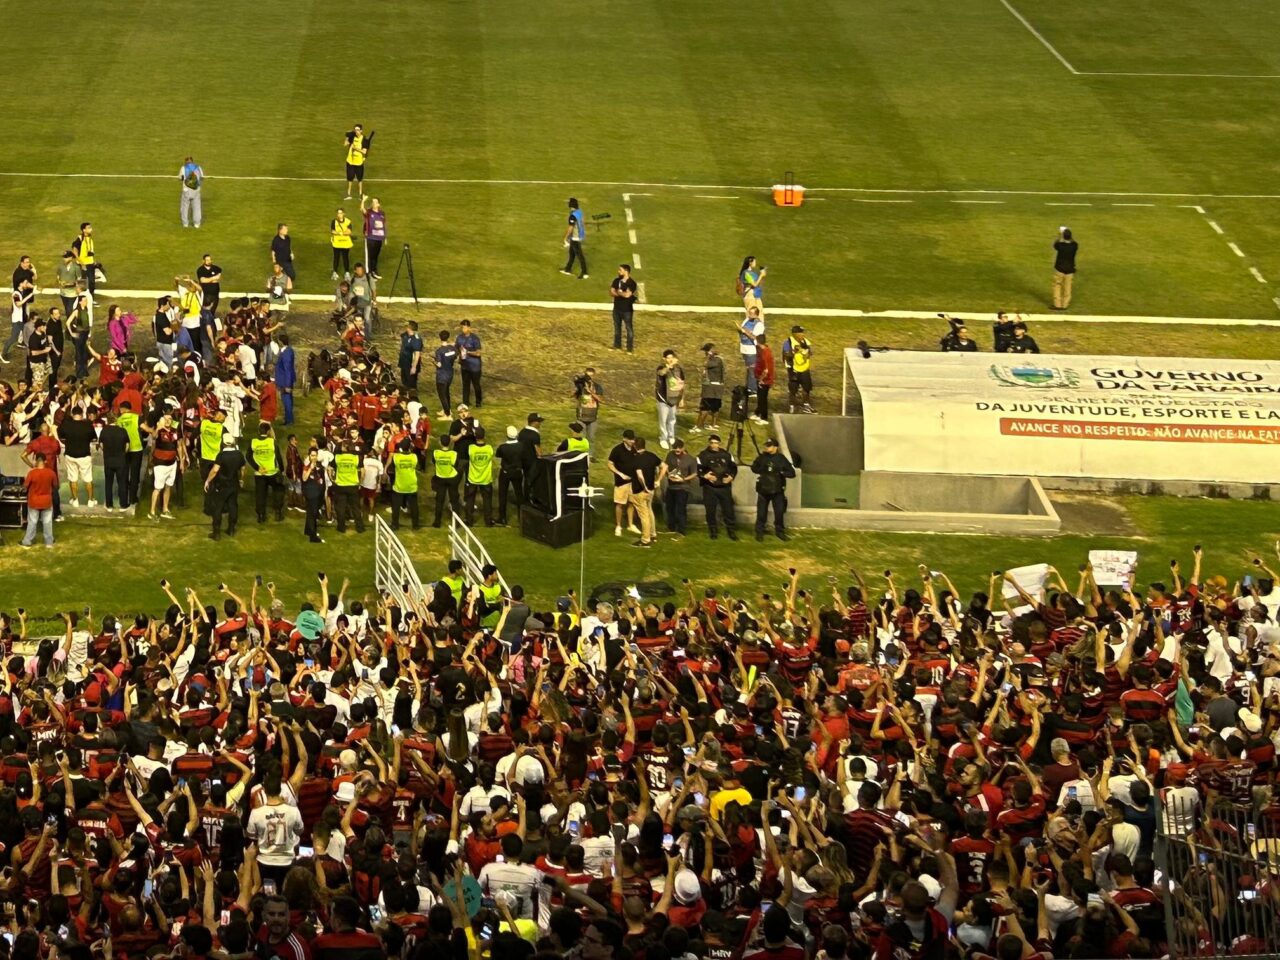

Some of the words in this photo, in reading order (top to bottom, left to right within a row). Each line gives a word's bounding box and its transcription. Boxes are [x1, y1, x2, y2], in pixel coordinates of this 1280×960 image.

[1094, 379, 1146, 391] DA
[976, 401, 1005, 412] DA
[1009, 403, 1137, 419] JUVENTUDE,
[1142, 407, 1233, 419] ESPORTE
[1238, 409, 1251, 419] E
[1010, 421, 1060, 434] AVANCE
[1063, 424, 1082, 435] NO
[1154, 425, 1181, 438] NÃO
[1185, 427, 1234, 440] AVANCE
[1237, 428, 1255, 440] NA
[931, 666, 944, 685] 10
[647, 764, 666, 789] 10
[969, 861, 984, 883] 3
